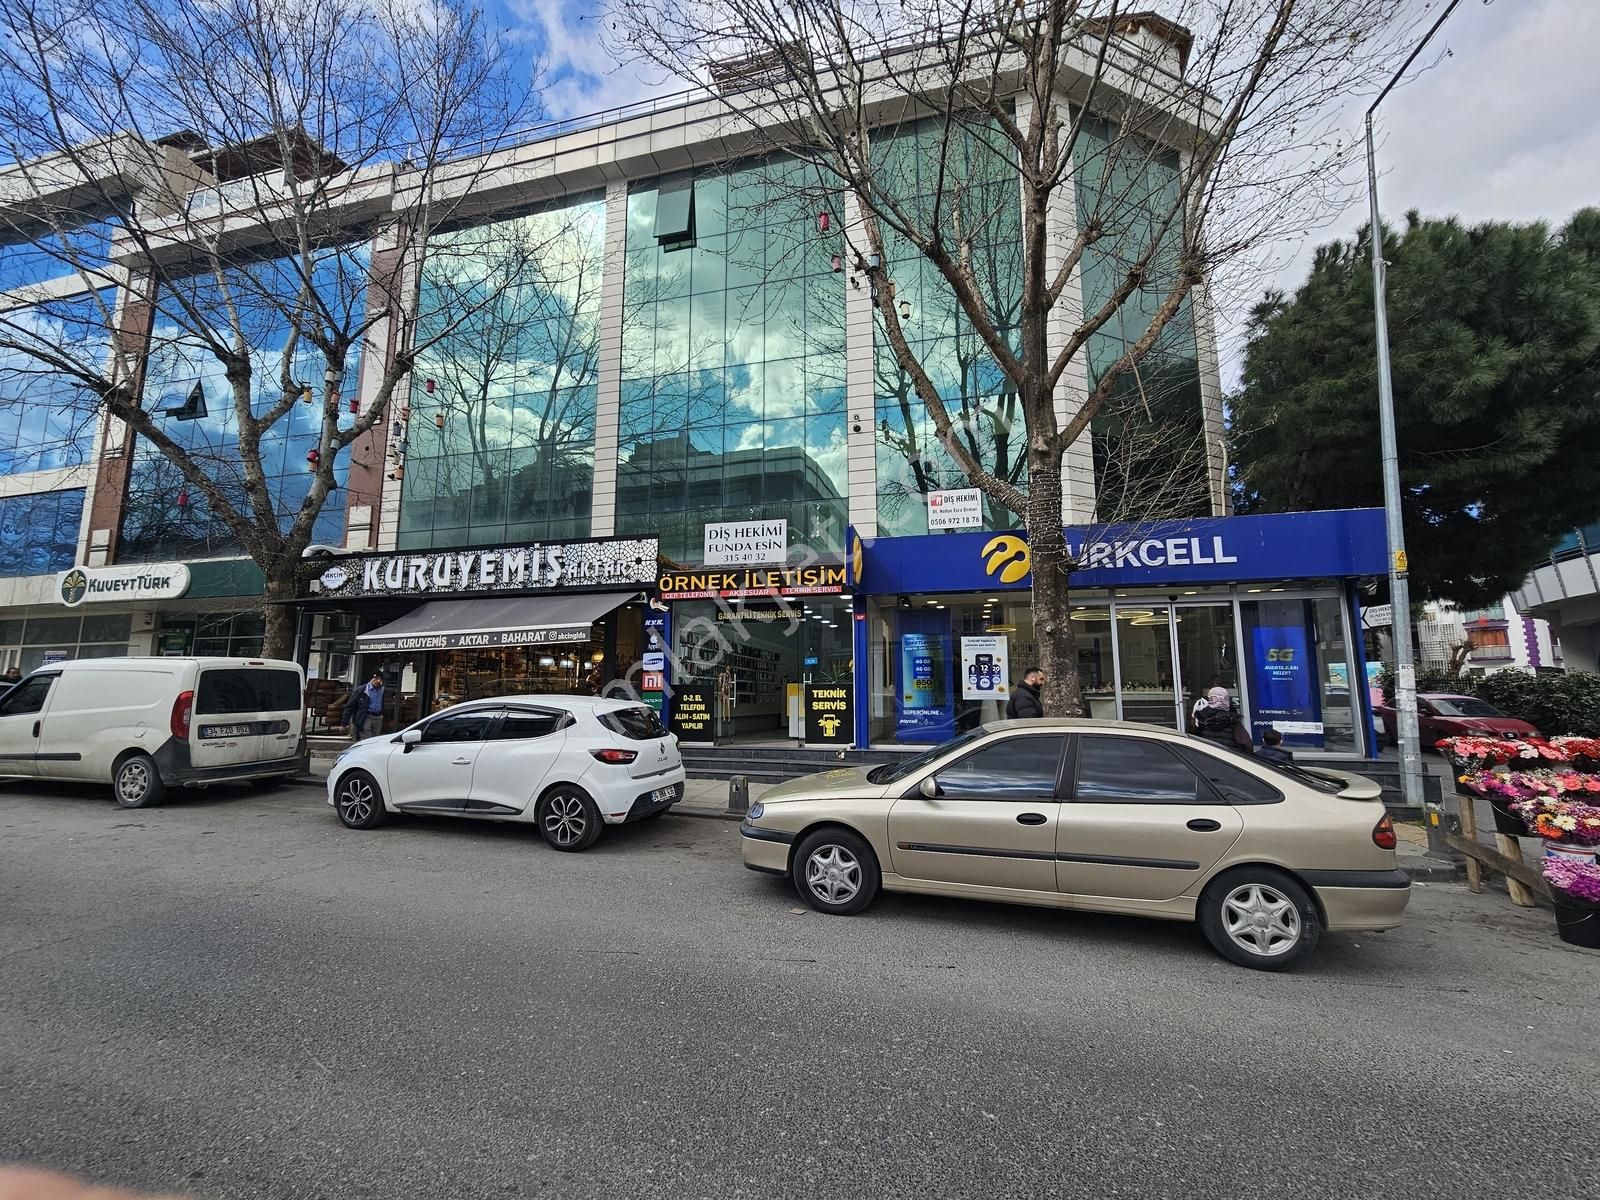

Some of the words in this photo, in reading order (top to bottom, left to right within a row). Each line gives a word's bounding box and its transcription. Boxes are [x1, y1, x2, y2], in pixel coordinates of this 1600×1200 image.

[944, 495, 955, 505] DİŞ
[709, 526, 731, 541] DİŞ
[735, 523, 782, 538] HEKİMİ
[709, 543, 752, 552] FUNDA
[756, 539, 782, 550] ESİN
[723, 554, 740, 562] 315
[742, 553, 752, 561] 40
[755, 552, 766, 560] 32
[1066, 536, 1238, 569] URKCELL
[363, 543, 562, 591] KURUYEMİŞ
[568, 559, 630, 578] AKTAR
[659, 573, 738, 591] ÖRNEK
[745, 566, 847, 588] İLETİŞİM
[753, 608, 777, 619] TEKNİK
[777, 608, 802, 618] SERVİS
[397, 636, 447, 649] KURUYEMİŞ
[459, 635, 490, 646] AKTAR
[501, 631, 546, 643] BAHARAT
[694, 694, 703, 702] EL
[812, 688, 847, 699] TEKNİK
[680, 703, 706, 711] TELEFON
[812, 700, 847, 710] SERVİS
